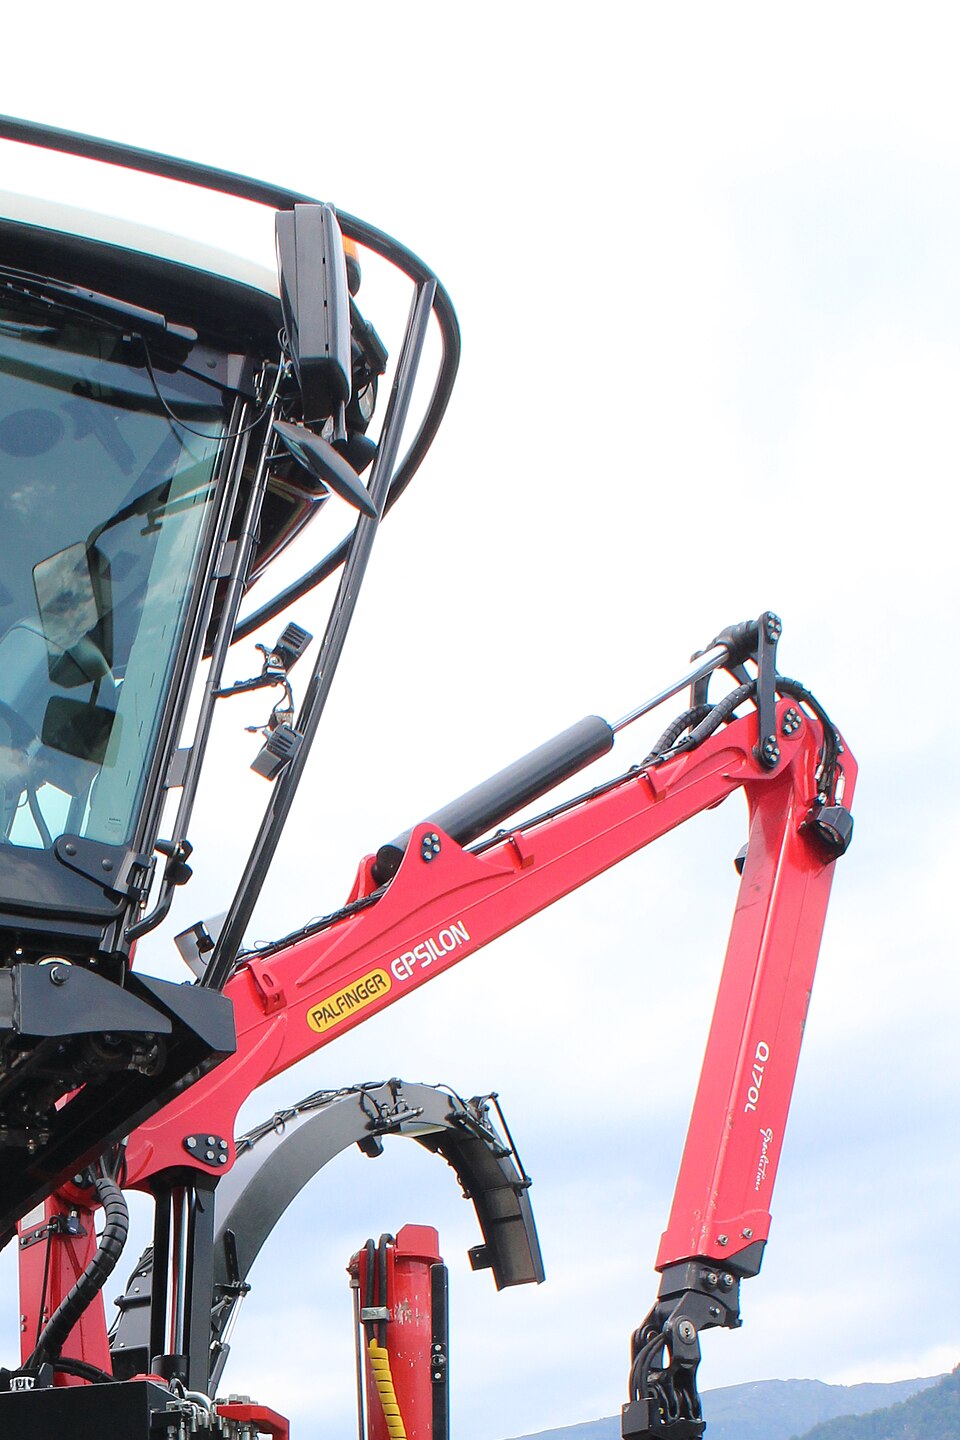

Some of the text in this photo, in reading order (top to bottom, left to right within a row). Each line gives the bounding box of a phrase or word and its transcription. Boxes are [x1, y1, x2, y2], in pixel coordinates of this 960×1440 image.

[310, 919, 472, 1028] PALFINGER EPSILON
[743, 1040, 770, 1114] Q170L
